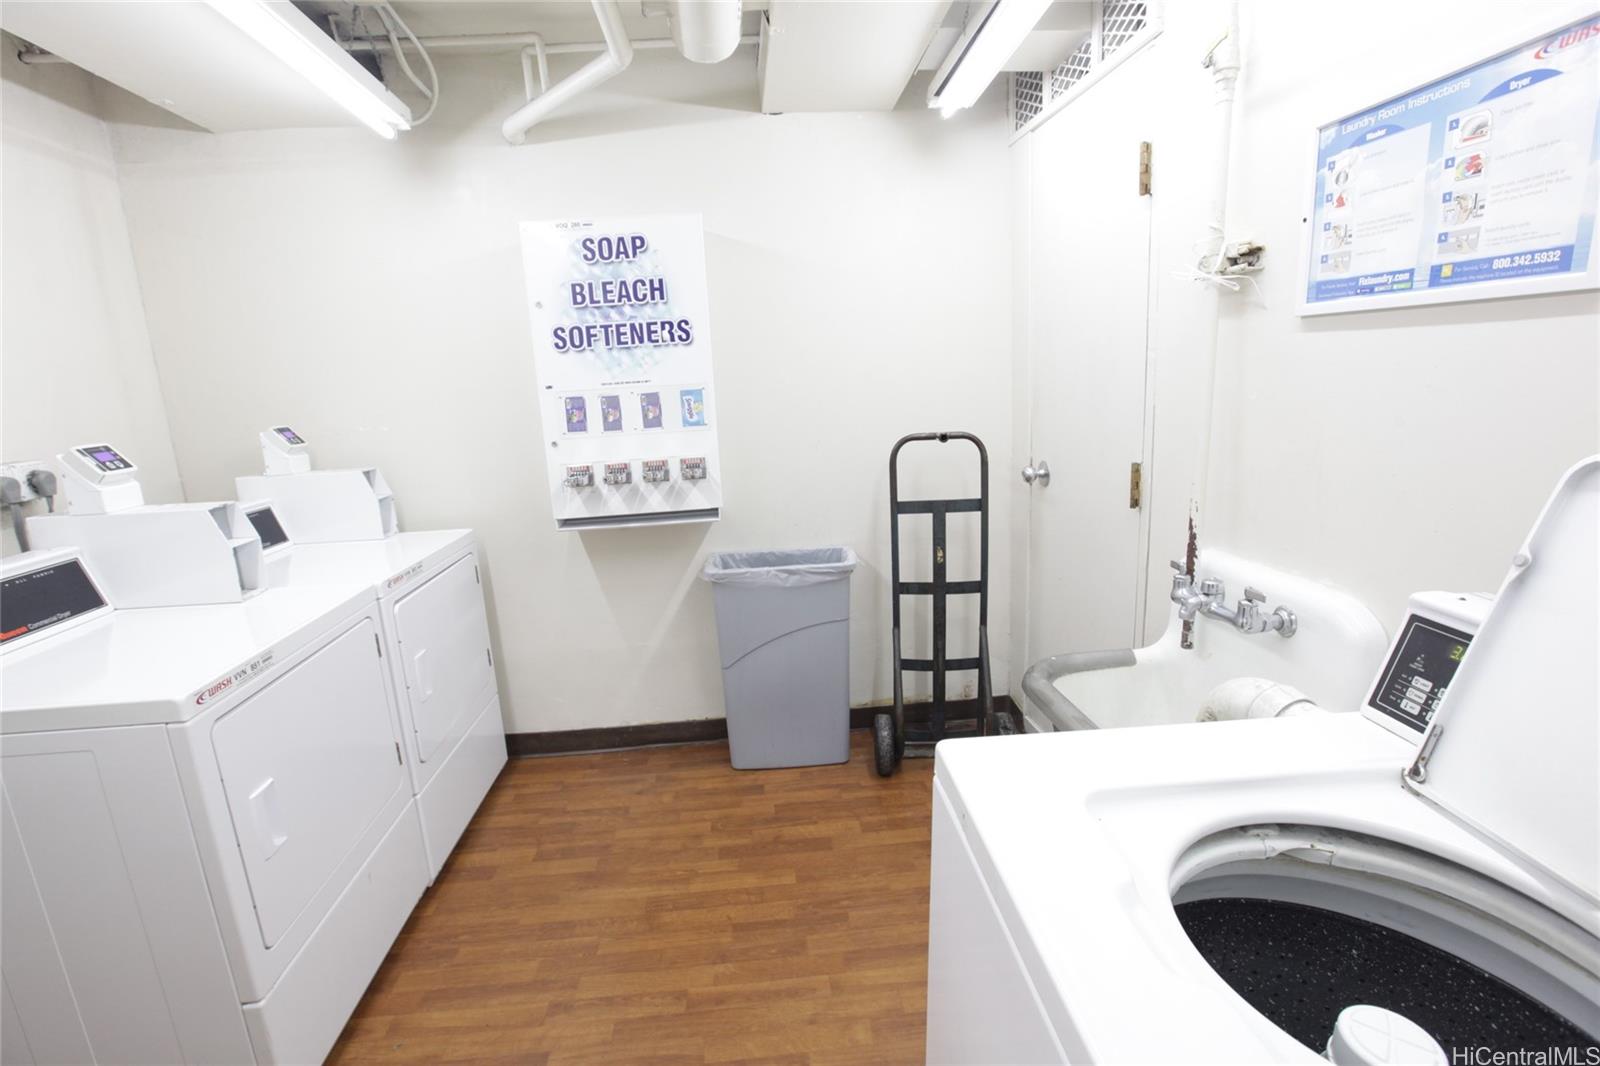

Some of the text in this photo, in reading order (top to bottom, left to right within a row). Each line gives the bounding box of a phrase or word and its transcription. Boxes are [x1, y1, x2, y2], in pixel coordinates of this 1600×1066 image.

[1509, 76, 1532, 91] Dryer
[1342, 78, 1471, 135] Laundry Room Instructions
[581, 234, 647, 262] SOAP
[1492, 250, 1561, 270] 800.342.5932
[570, 278, 666, 307] BLEACH
[553, 319, 693, 352] SOFTENERS
[207, 676, 233, 697] WASH
